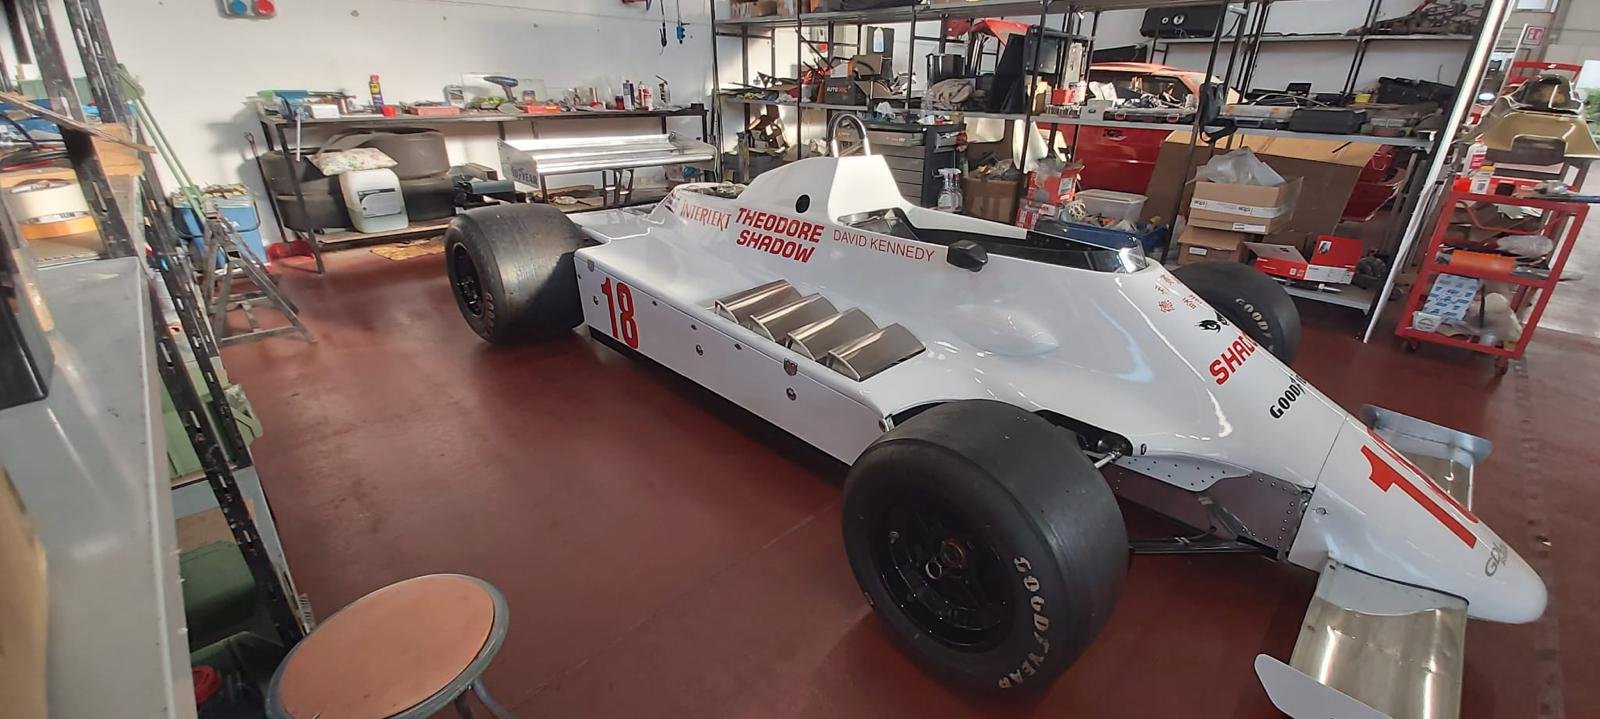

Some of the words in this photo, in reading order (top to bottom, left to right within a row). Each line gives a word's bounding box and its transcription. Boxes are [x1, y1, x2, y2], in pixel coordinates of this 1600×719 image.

[735, 207, 825, 243] THEODORE
[736, 229, 816, 263] SHADOW
[833, 229, 867, 247] DAVID
[870, 237, 935, 262] KENNEDY
[601, 276, 640, 350] 18
[1209, 333, 1257, 385] SHAD
[998, 556, 1050, 689] GOODYEAR
